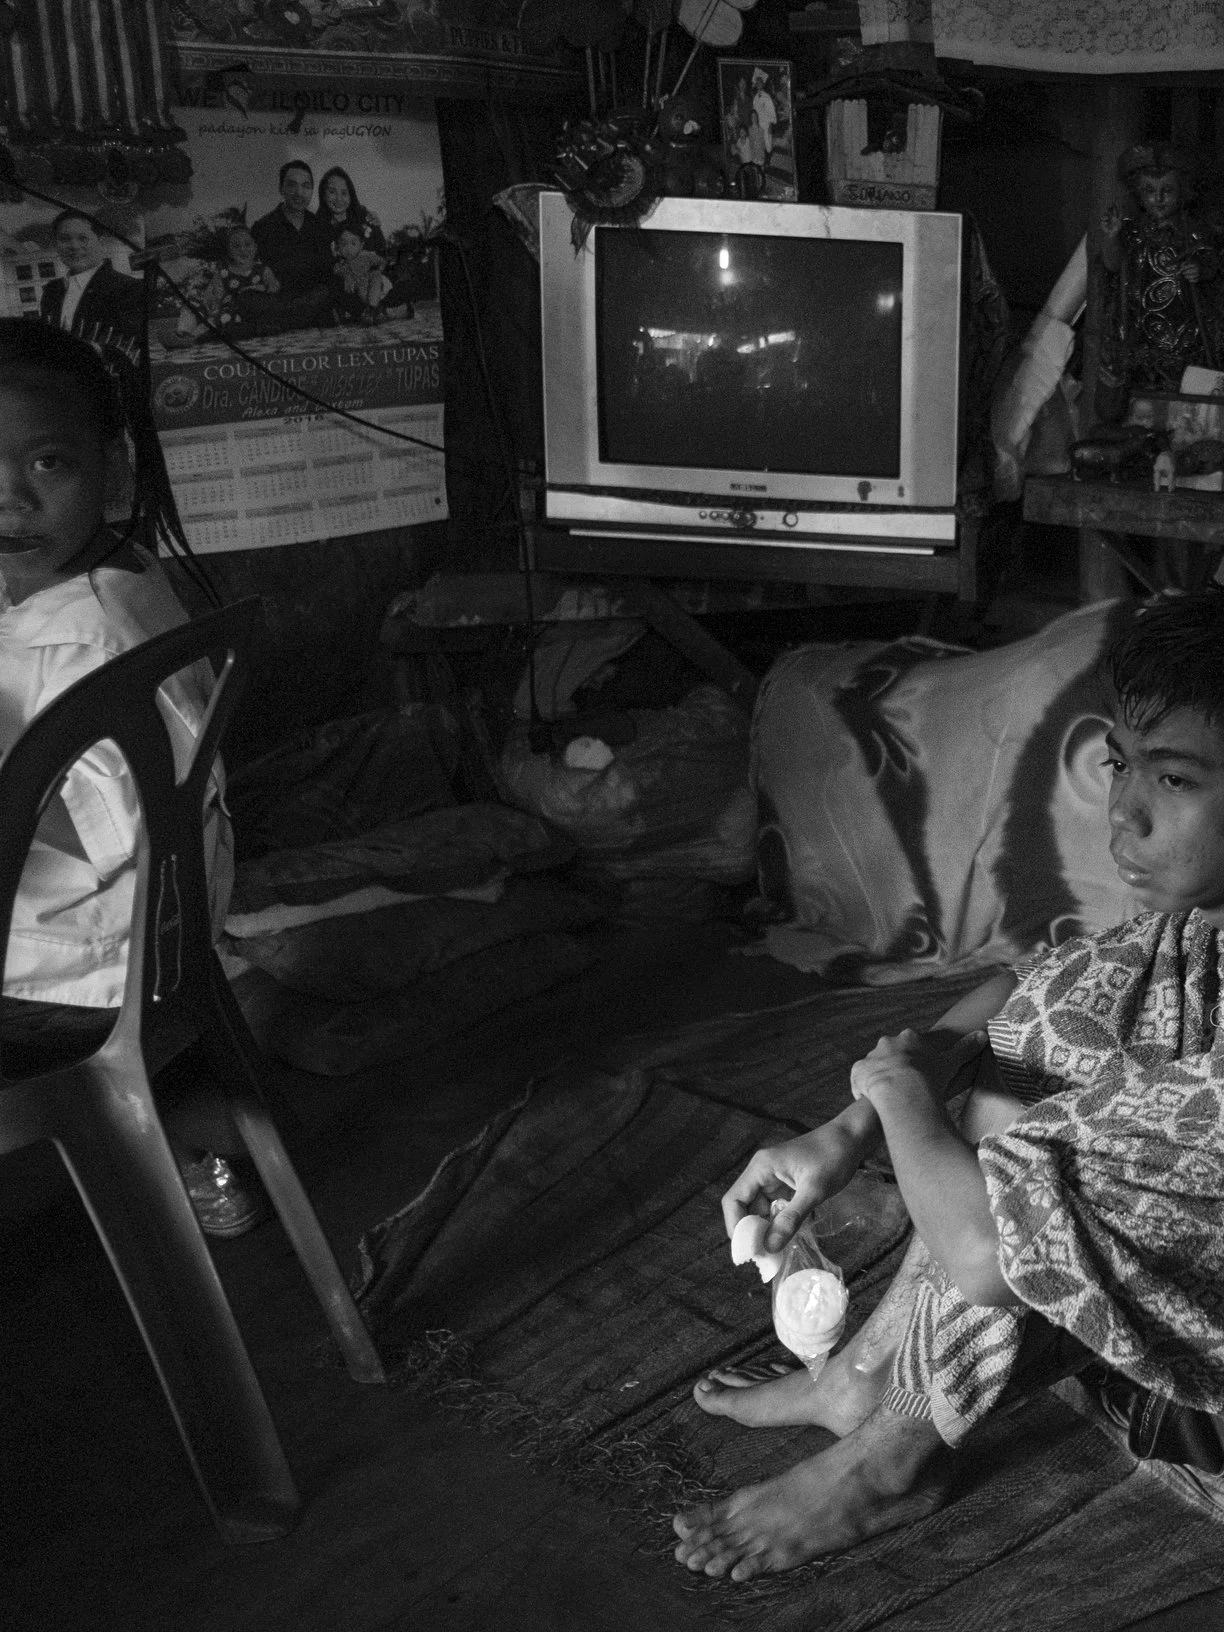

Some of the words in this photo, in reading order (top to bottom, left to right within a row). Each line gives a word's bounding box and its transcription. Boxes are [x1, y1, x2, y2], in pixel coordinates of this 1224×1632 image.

[271, 90, 350, 112] ILOILO
[358, 93, 406, 113] CITY
[199, 121, 265, 139] padayon
[304, 127, 318, 137] sa
[323, 124, 392, 140] pagUGYON
[203, 353, 331, 381] COUNCILOR
[337, 351, 375, 368] LEX
[380, 345, 440, 364] TUPAS
[202, 384, 233, 409] Dra.
[238, 376, 306, 406] CANDICE
[394, 363, 440, 393] TUPAS
[242, 405, 278, 418] Alexa
[284, 401, 308, 414] and
[283, 414, 325, 425] 2016
